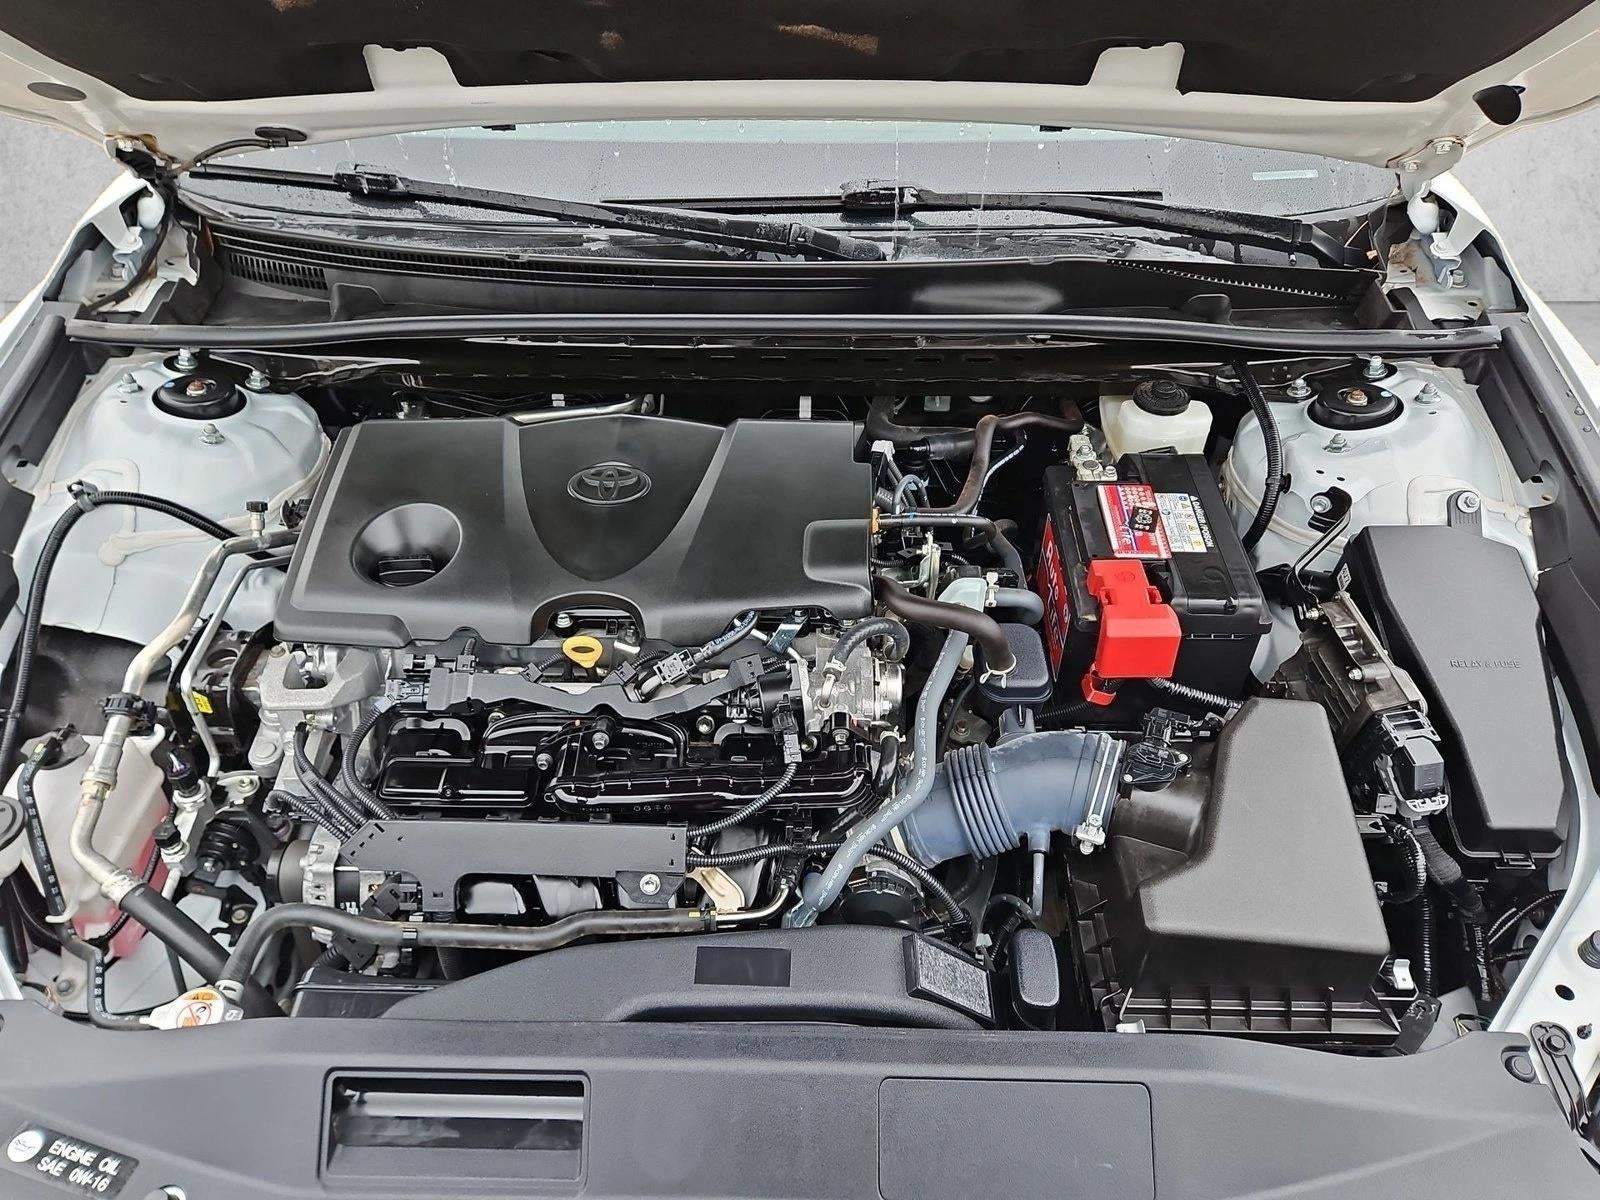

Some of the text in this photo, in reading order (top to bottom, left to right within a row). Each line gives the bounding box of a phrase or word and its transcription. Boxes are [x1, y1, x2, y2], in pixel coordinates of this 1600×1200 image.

[1192, 501, 1206, 524] DANGER
[1046, 540, 1059, 601] Auto
[1449, 659, 1482, 669] RELAY
[36, 1156, 111, 1192] SAE 0W-16
[48, 1139, 122, 1176] ENGINE OIL
